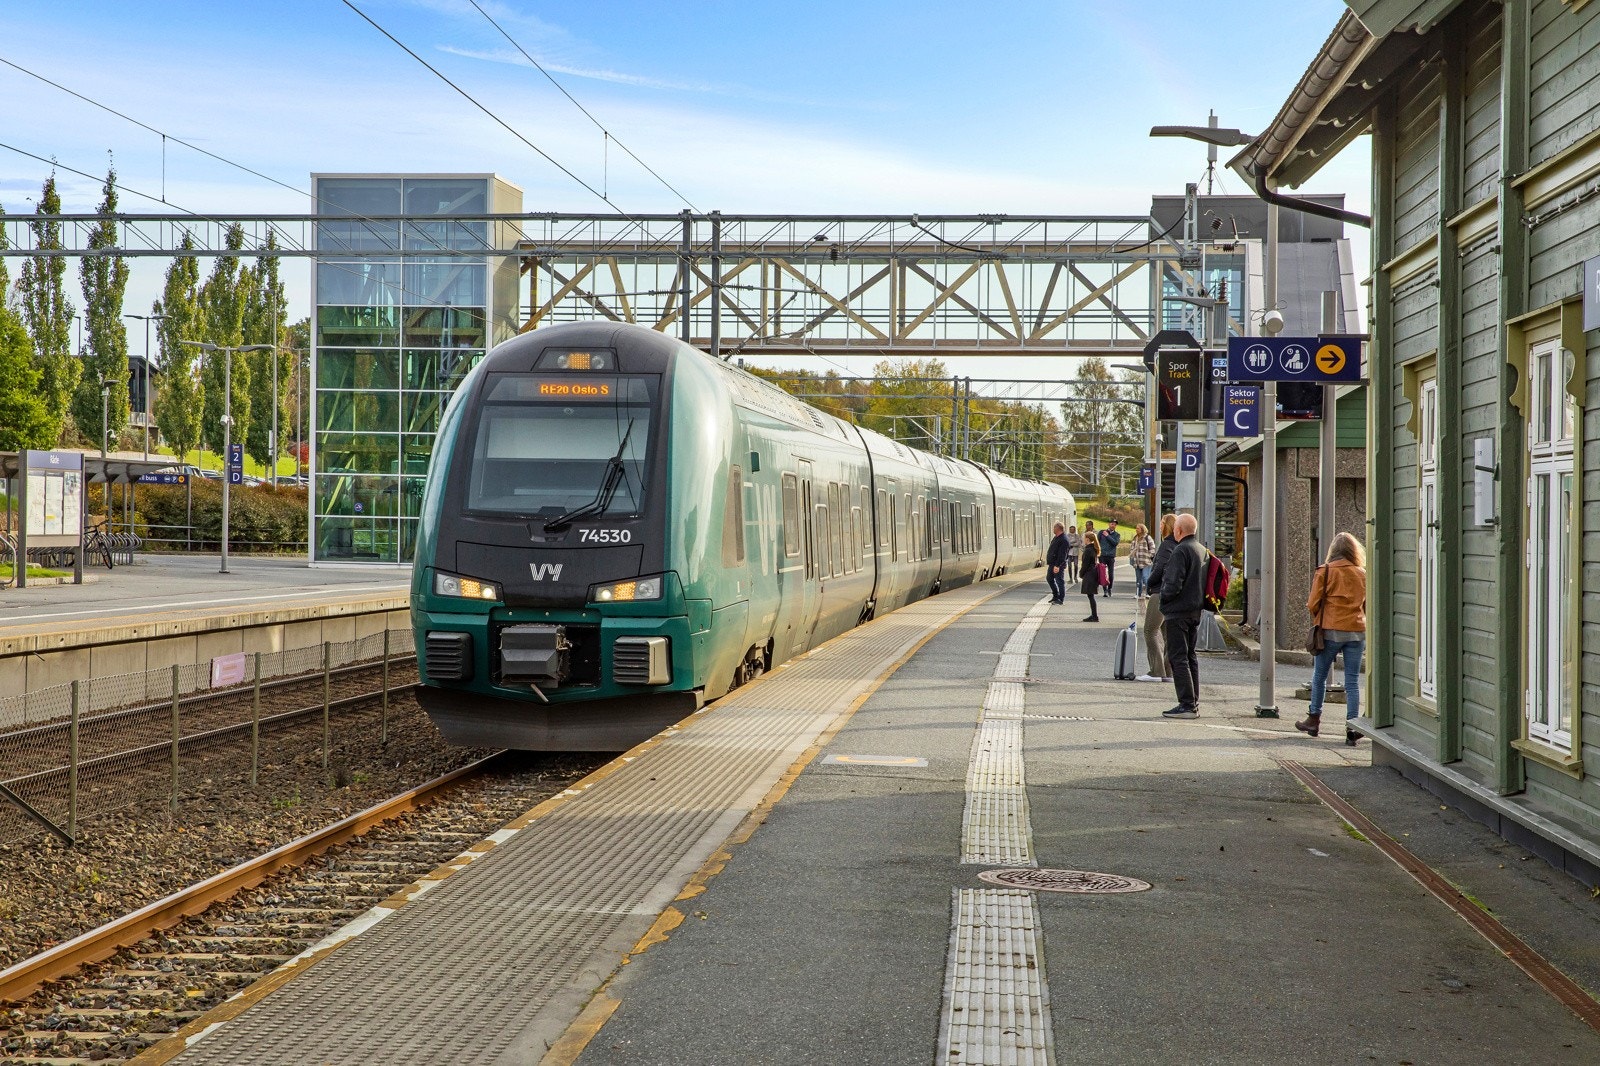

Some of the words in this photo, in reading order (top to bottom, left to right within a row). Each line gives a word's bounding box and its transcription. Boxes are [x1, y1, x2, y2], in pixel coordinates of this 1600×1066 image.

[1168, 361, 1188, 371] Spor
[1168, 370, 1191, 379] Track
[1212, 368, 1226, 377] Os
[540, 384, 569, 395] RE20
[572, 384, 598, 395] Oslo
[600, 384, 609, 395] S
[1229, 389, 1255, 397] Sektor
[1174, 385, 1182, 406] 1
[1229, 397, 1255, 405] Sector
[1233, 408, 1250, 429] C
[233, 452, 239, 461] 2
[1186, 454, 1197, 467] D
[232, 472, 240, 482] D
[1145, 477, 1149, 486] 1
[579, 529, 631, 543] 74530
